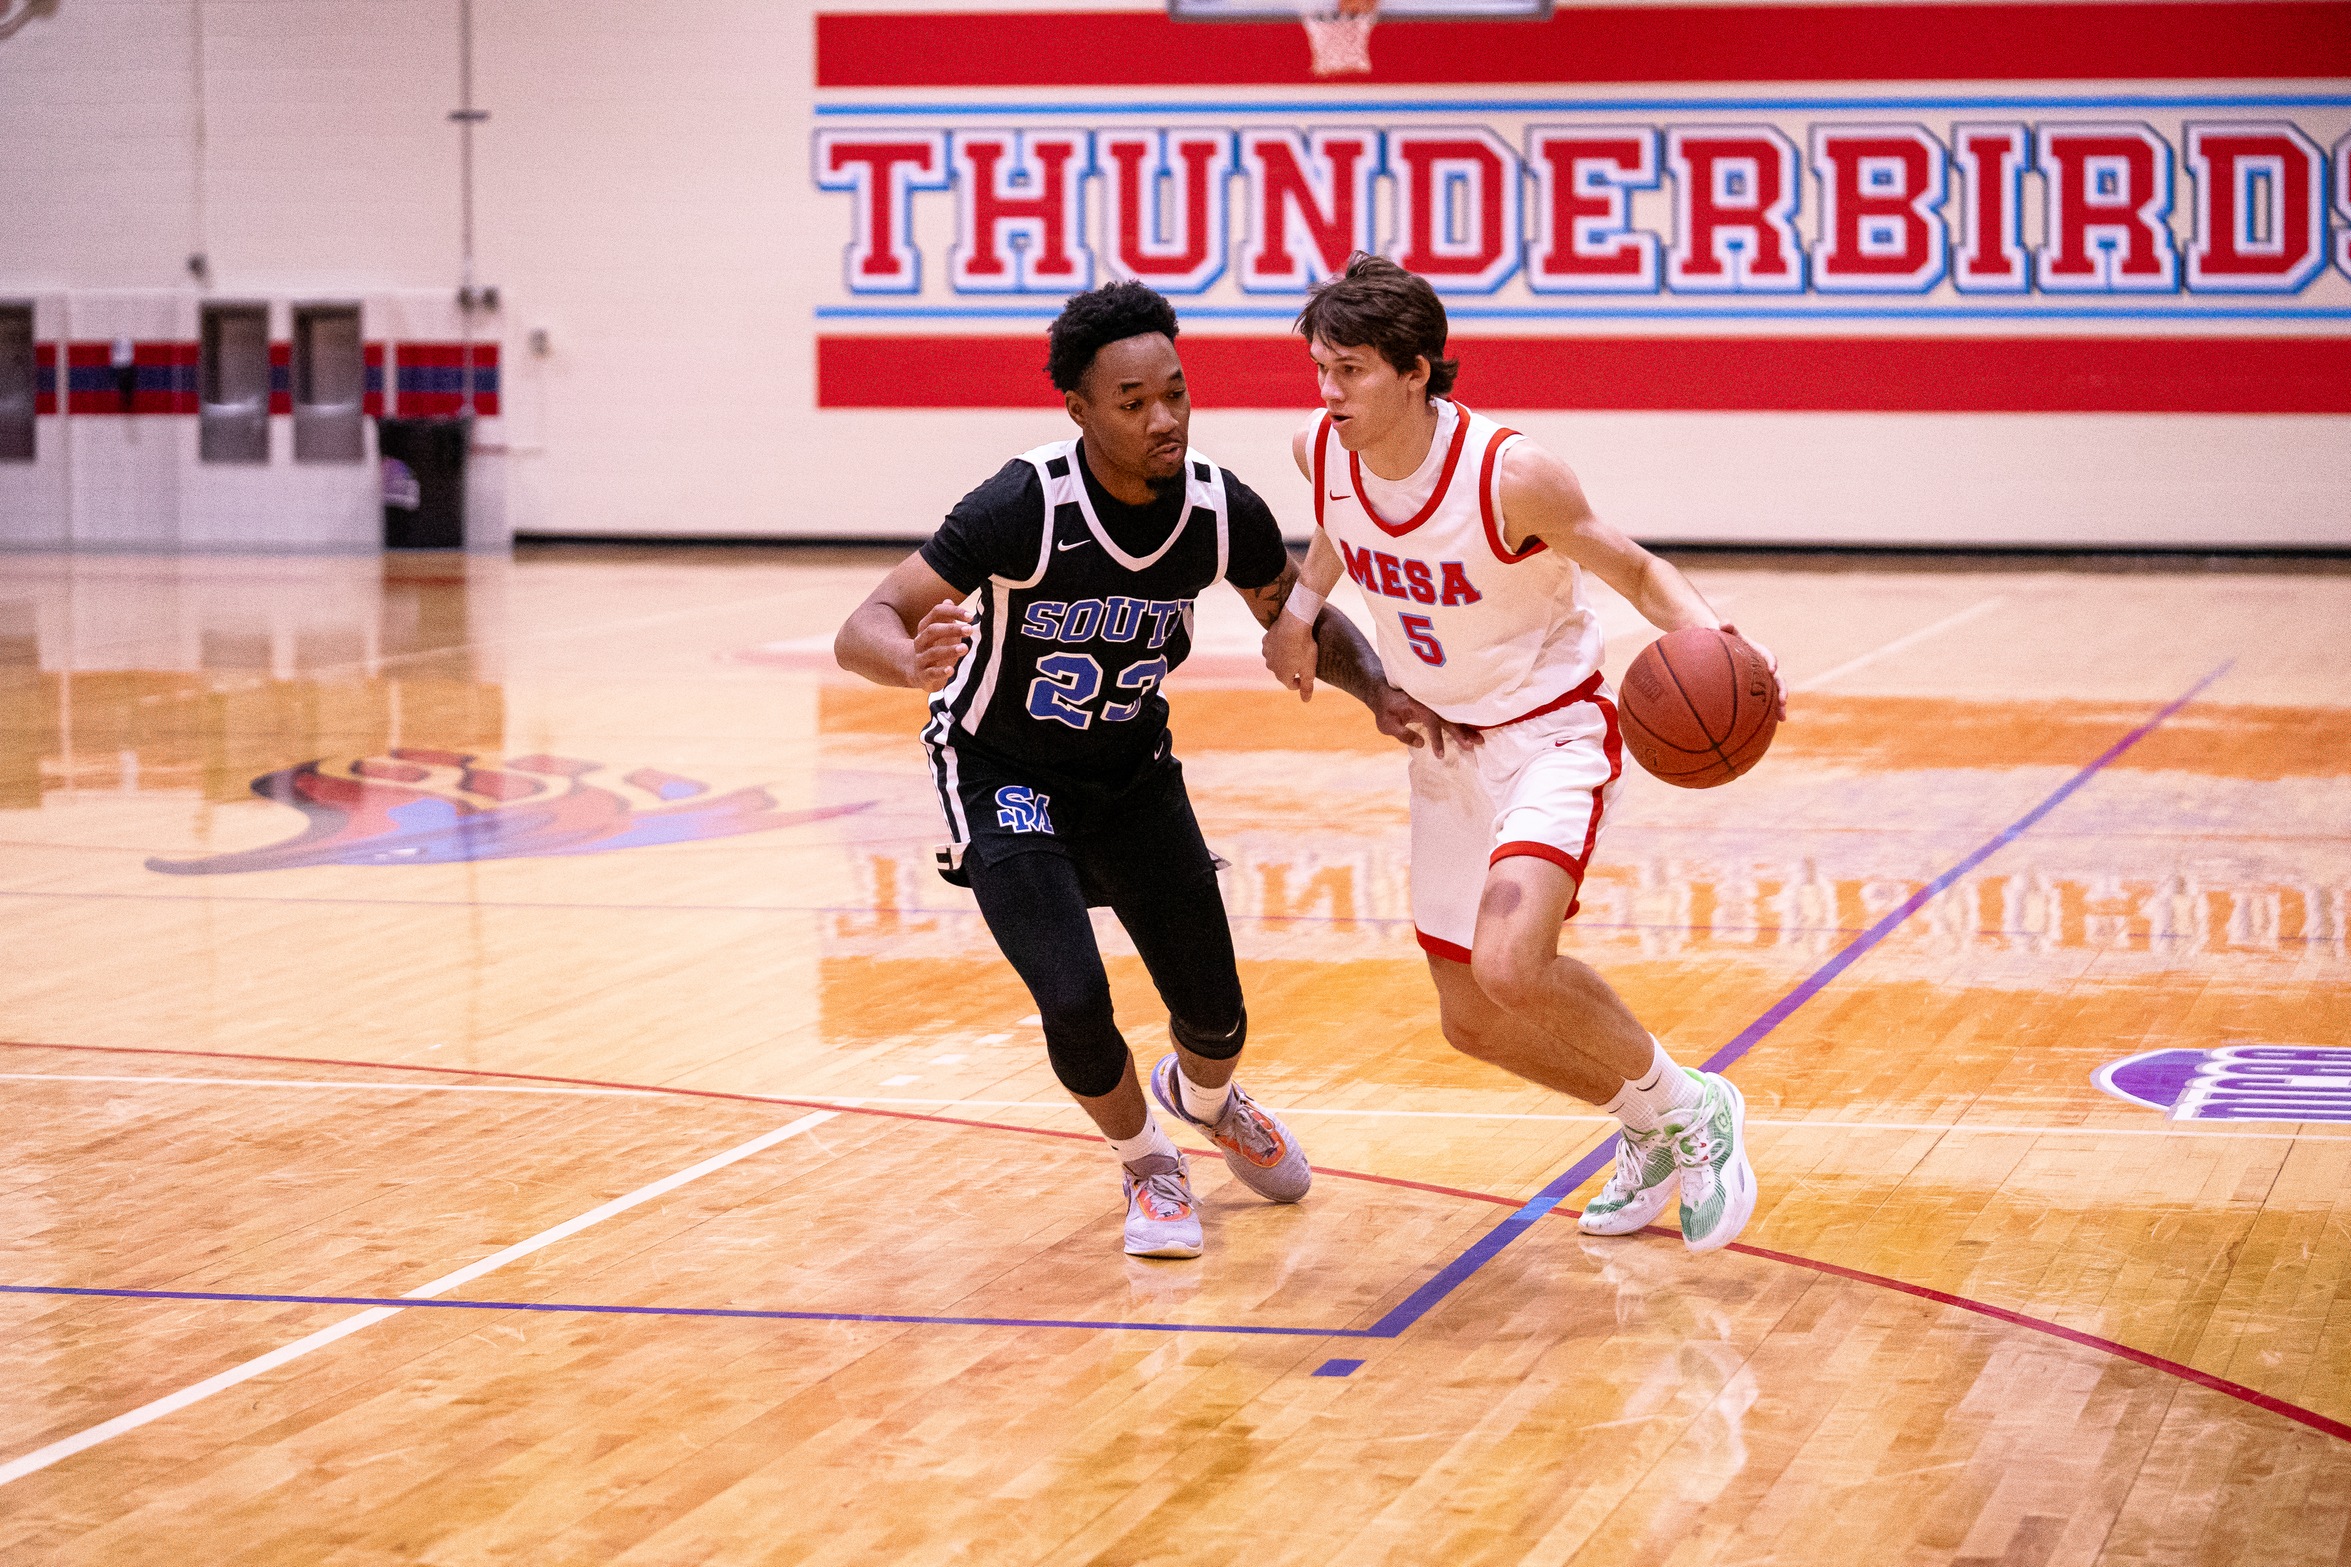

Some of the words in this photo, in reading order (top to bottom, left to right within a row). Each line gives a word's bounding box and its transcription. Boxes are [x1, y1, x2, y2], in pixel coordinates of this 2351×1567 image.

[814, 122, 2351, 297] THUNDERBIRD
[1338, 538, 1483, 607] MESA
[1398, 611, 1447, 667] 5
[1025, 651, 1168, 730] 23
